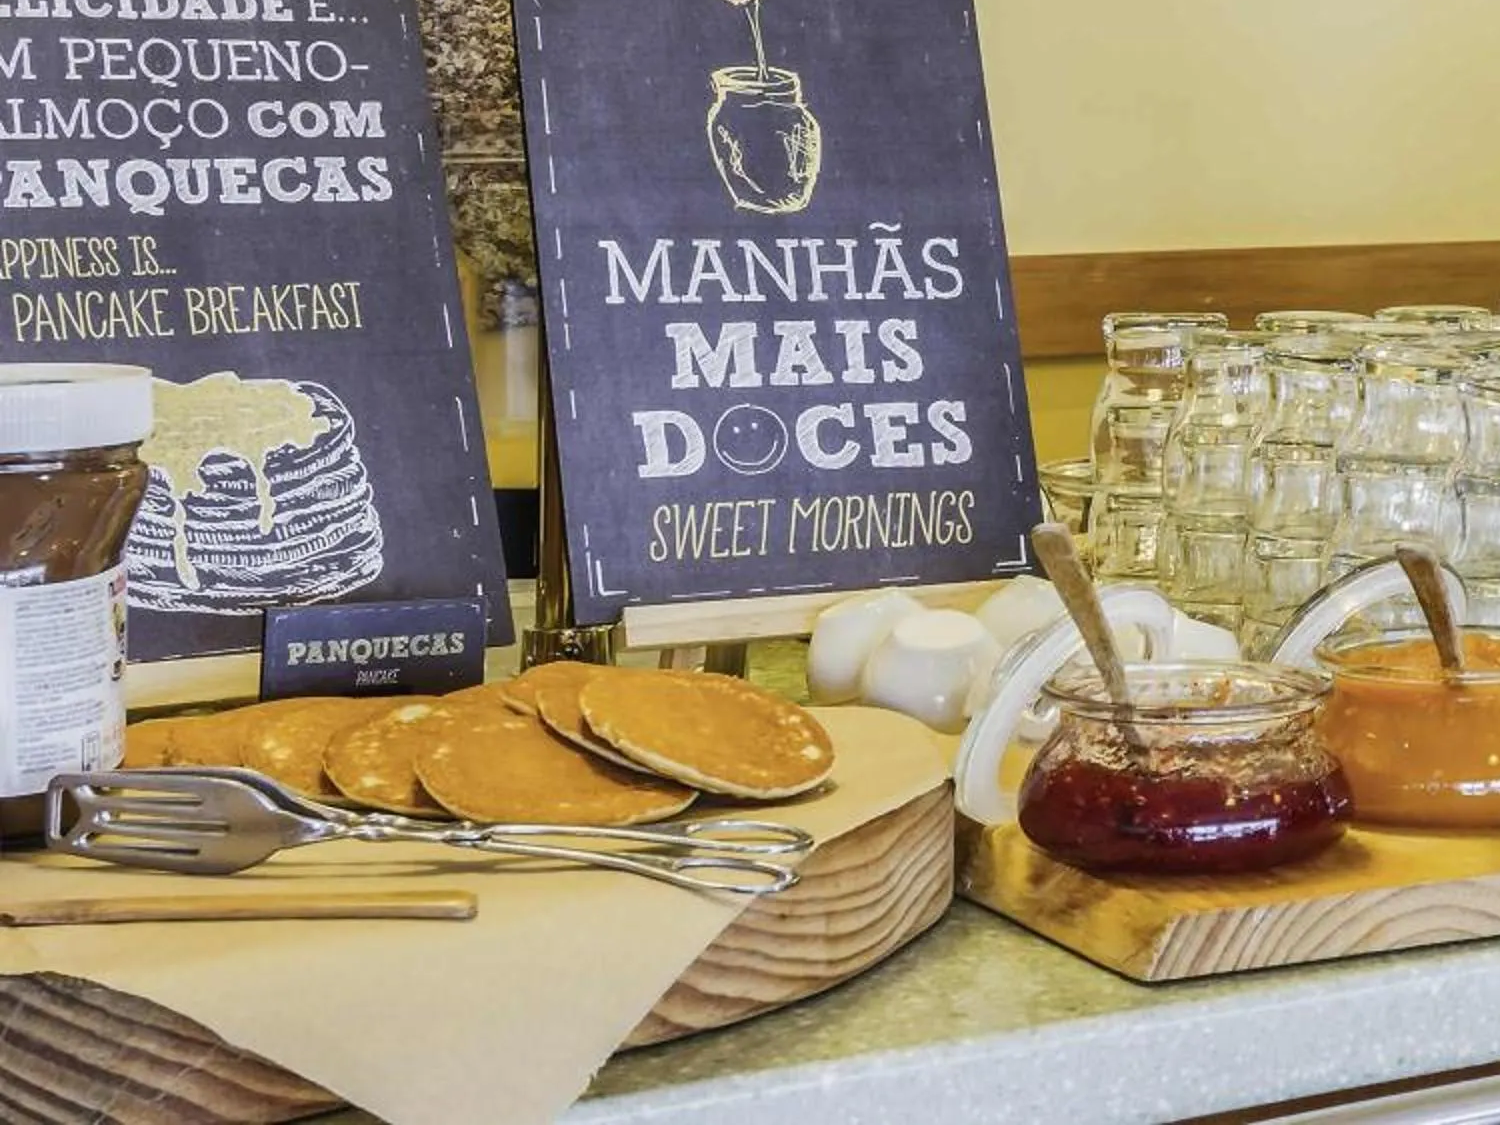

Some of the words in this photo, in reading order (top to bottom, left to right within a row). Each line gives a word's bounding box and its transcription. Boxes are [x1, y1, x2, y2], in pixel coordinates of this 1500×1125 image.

[60, 38, 369, 88] PEQUENO-
[0, 98, 229, 150] LMOÇO
[247, 101, 386, 139] COM
[0, 157, 393, 216] ANQUECAS
[599, 222, 963, 304] MANHÃS
[13, 289, 174, 342] PANCAKE
[184, 282, 363, 334] BREAKFAST
[665, 319, 923, 388] MAIS
[650, 499, 775, 561] SWEET
[789, 491, 975, 550] MORNINGS
[287, 632, 465, 665] PANQUECAS
